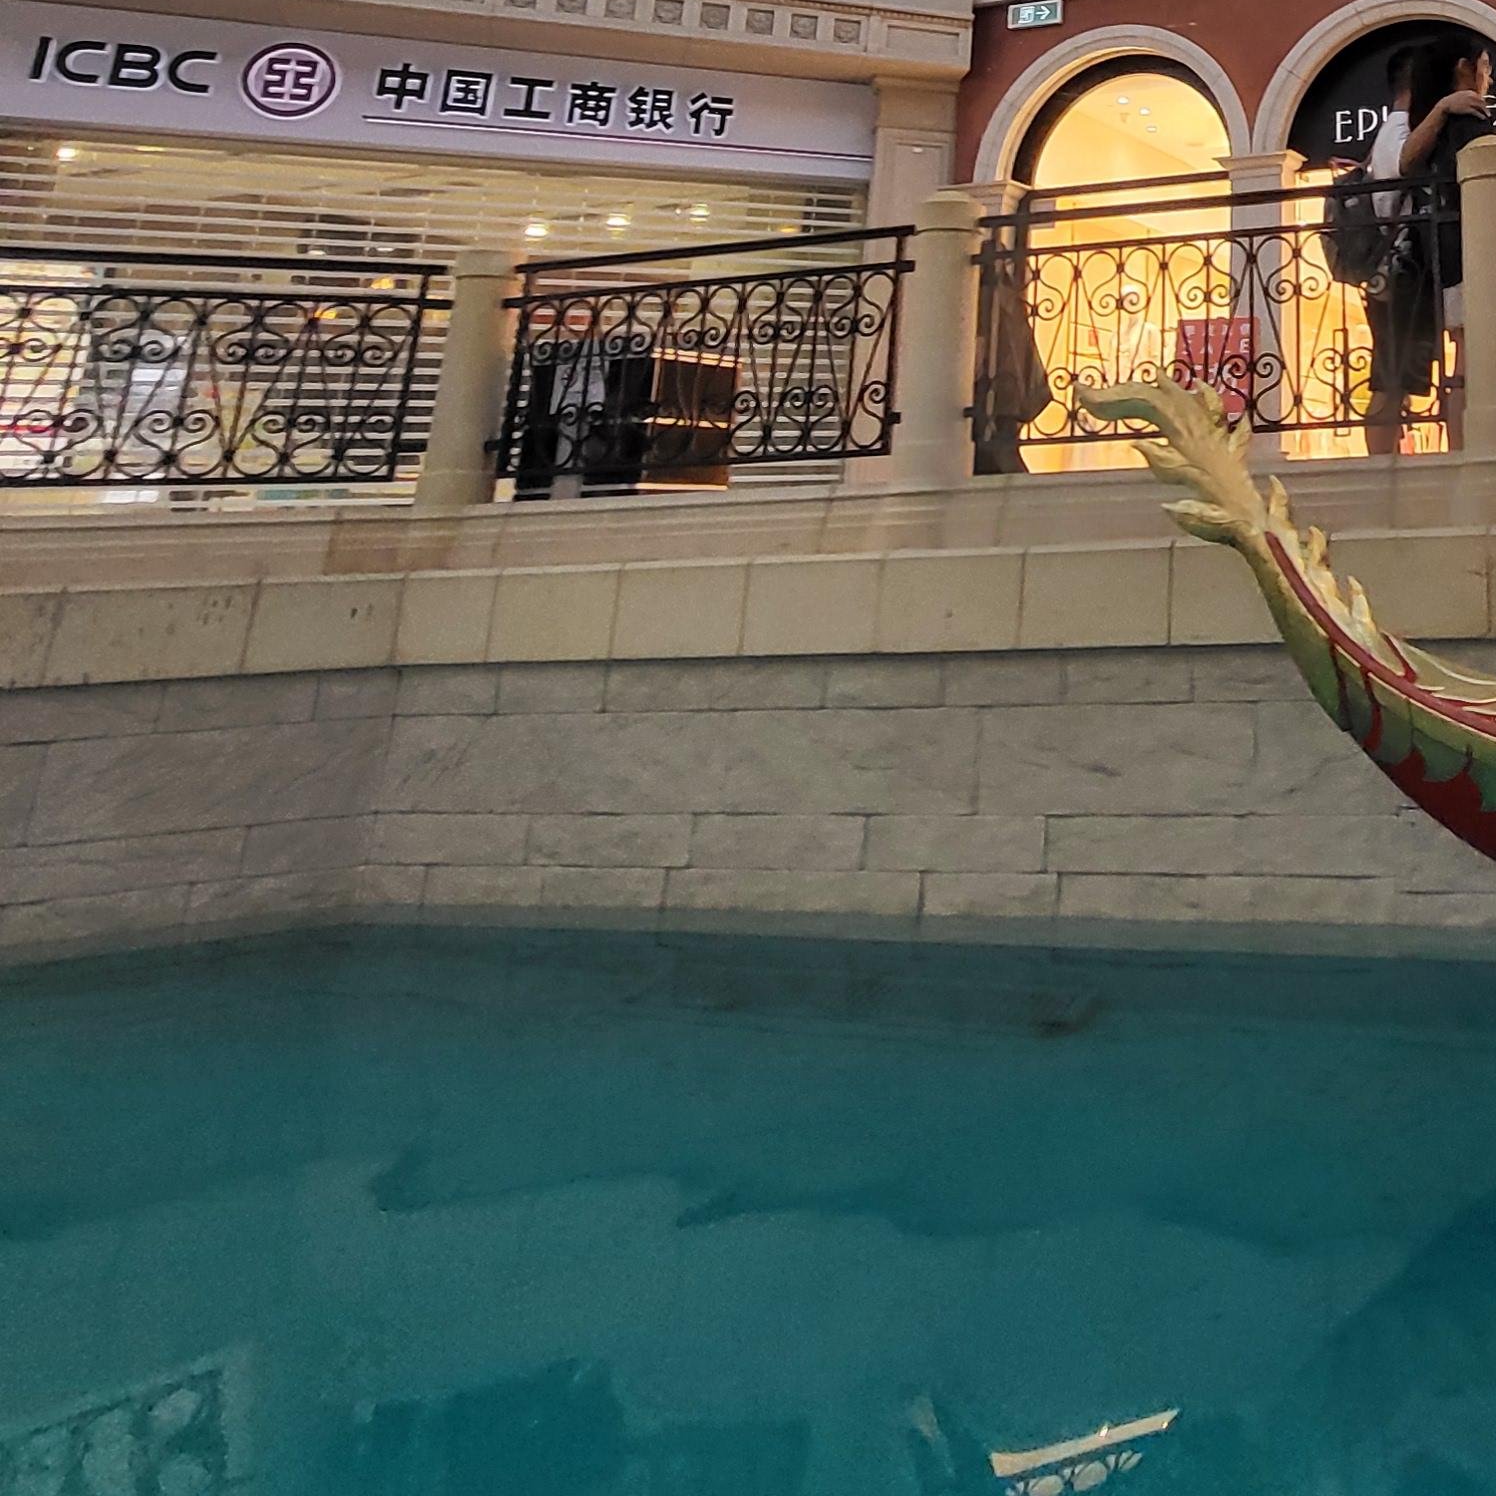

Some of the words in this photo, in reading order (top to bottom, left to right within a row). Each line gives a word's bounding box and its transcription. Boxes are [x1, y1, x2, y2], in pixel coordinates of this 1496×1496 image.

[29, 36, 218, 94] ICBC
[375, 62, 736, 137] 中国工商银行
